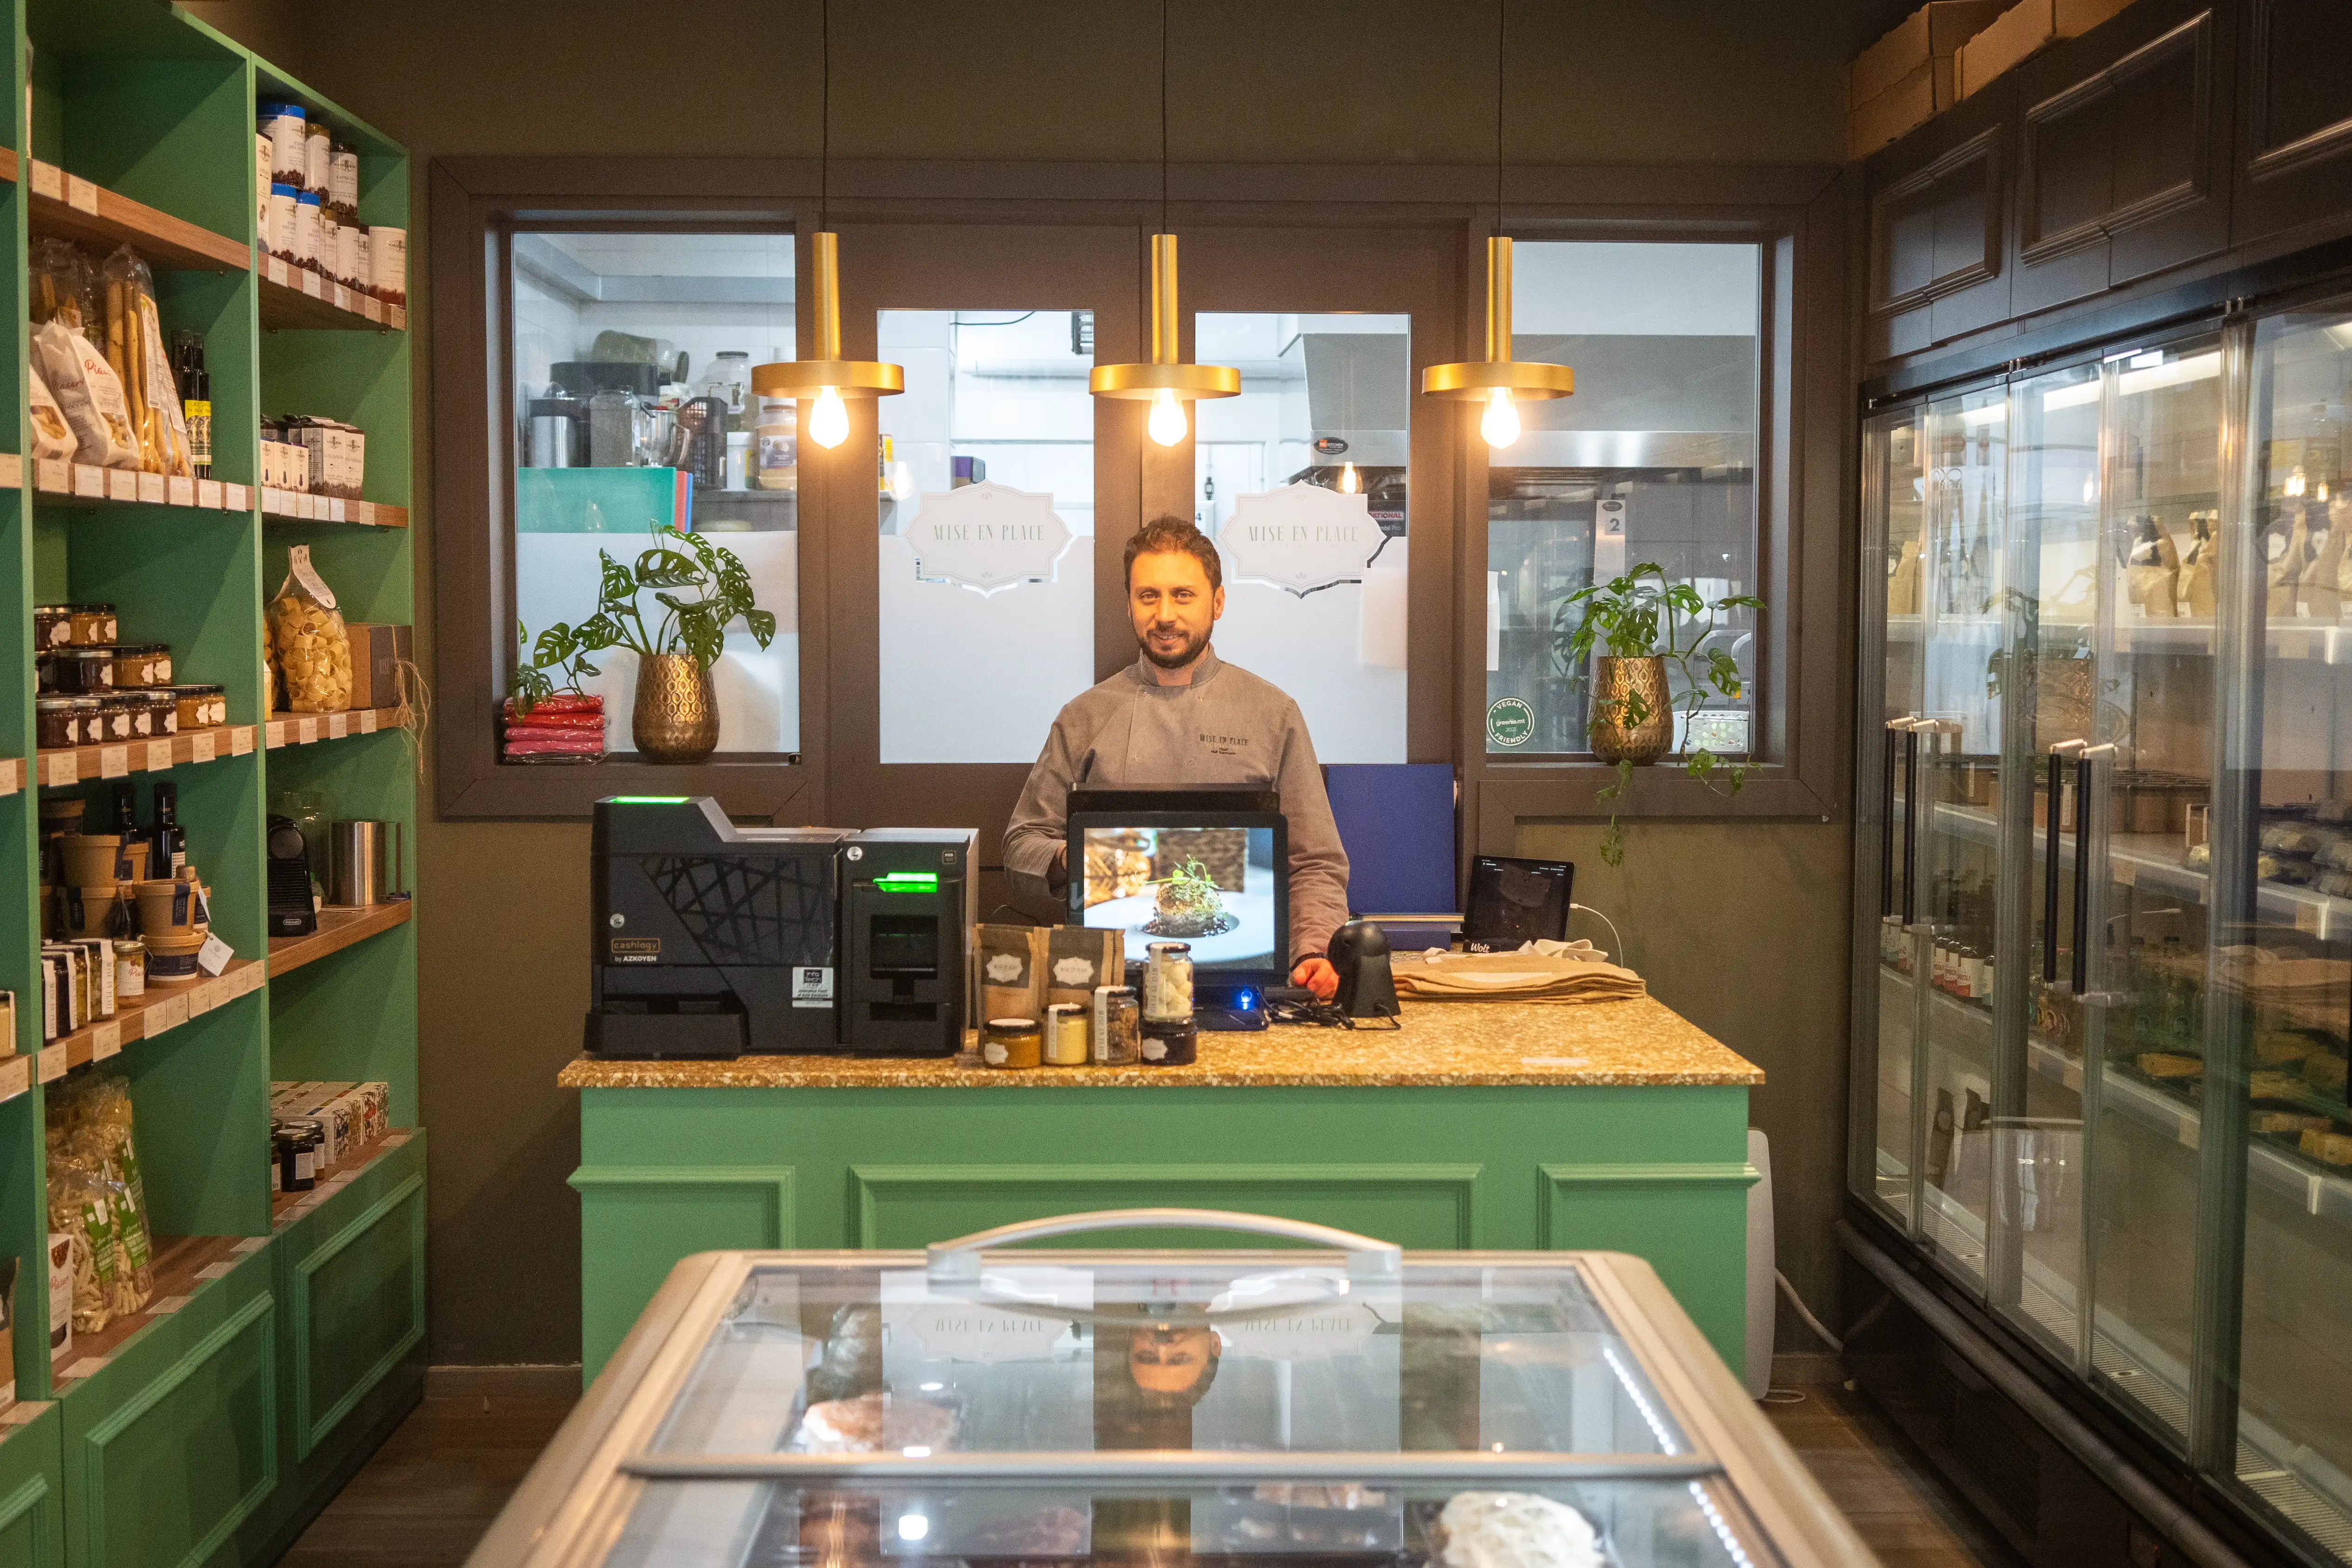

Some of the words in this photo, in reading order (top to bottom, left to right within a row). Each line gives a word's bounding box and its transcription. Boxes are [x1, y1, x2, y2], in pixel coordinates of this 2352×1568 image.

[1609, 518, 1620, 531] 2
[933, 524, 969, 540] MISE
[978, 524, 994, 540] EN
[1002, 524, 1044, 541] PLACE
[1248, 525, 1283, 541] MISE
[1293, 525, 1307, 541] EN
[1316, 525, 1358, 542] PLACE
[1496, 700, 1523, 710] VEGAN
[1496, 718, 1526, 727] greenie.mt
[1199, 734, 1216, 742] MISE
[1230, 737, 1248, 746] PLACE
[1494, 730, 1528, 743] FRIENDLY
[1470, 942, 1490, 953] Wolt
